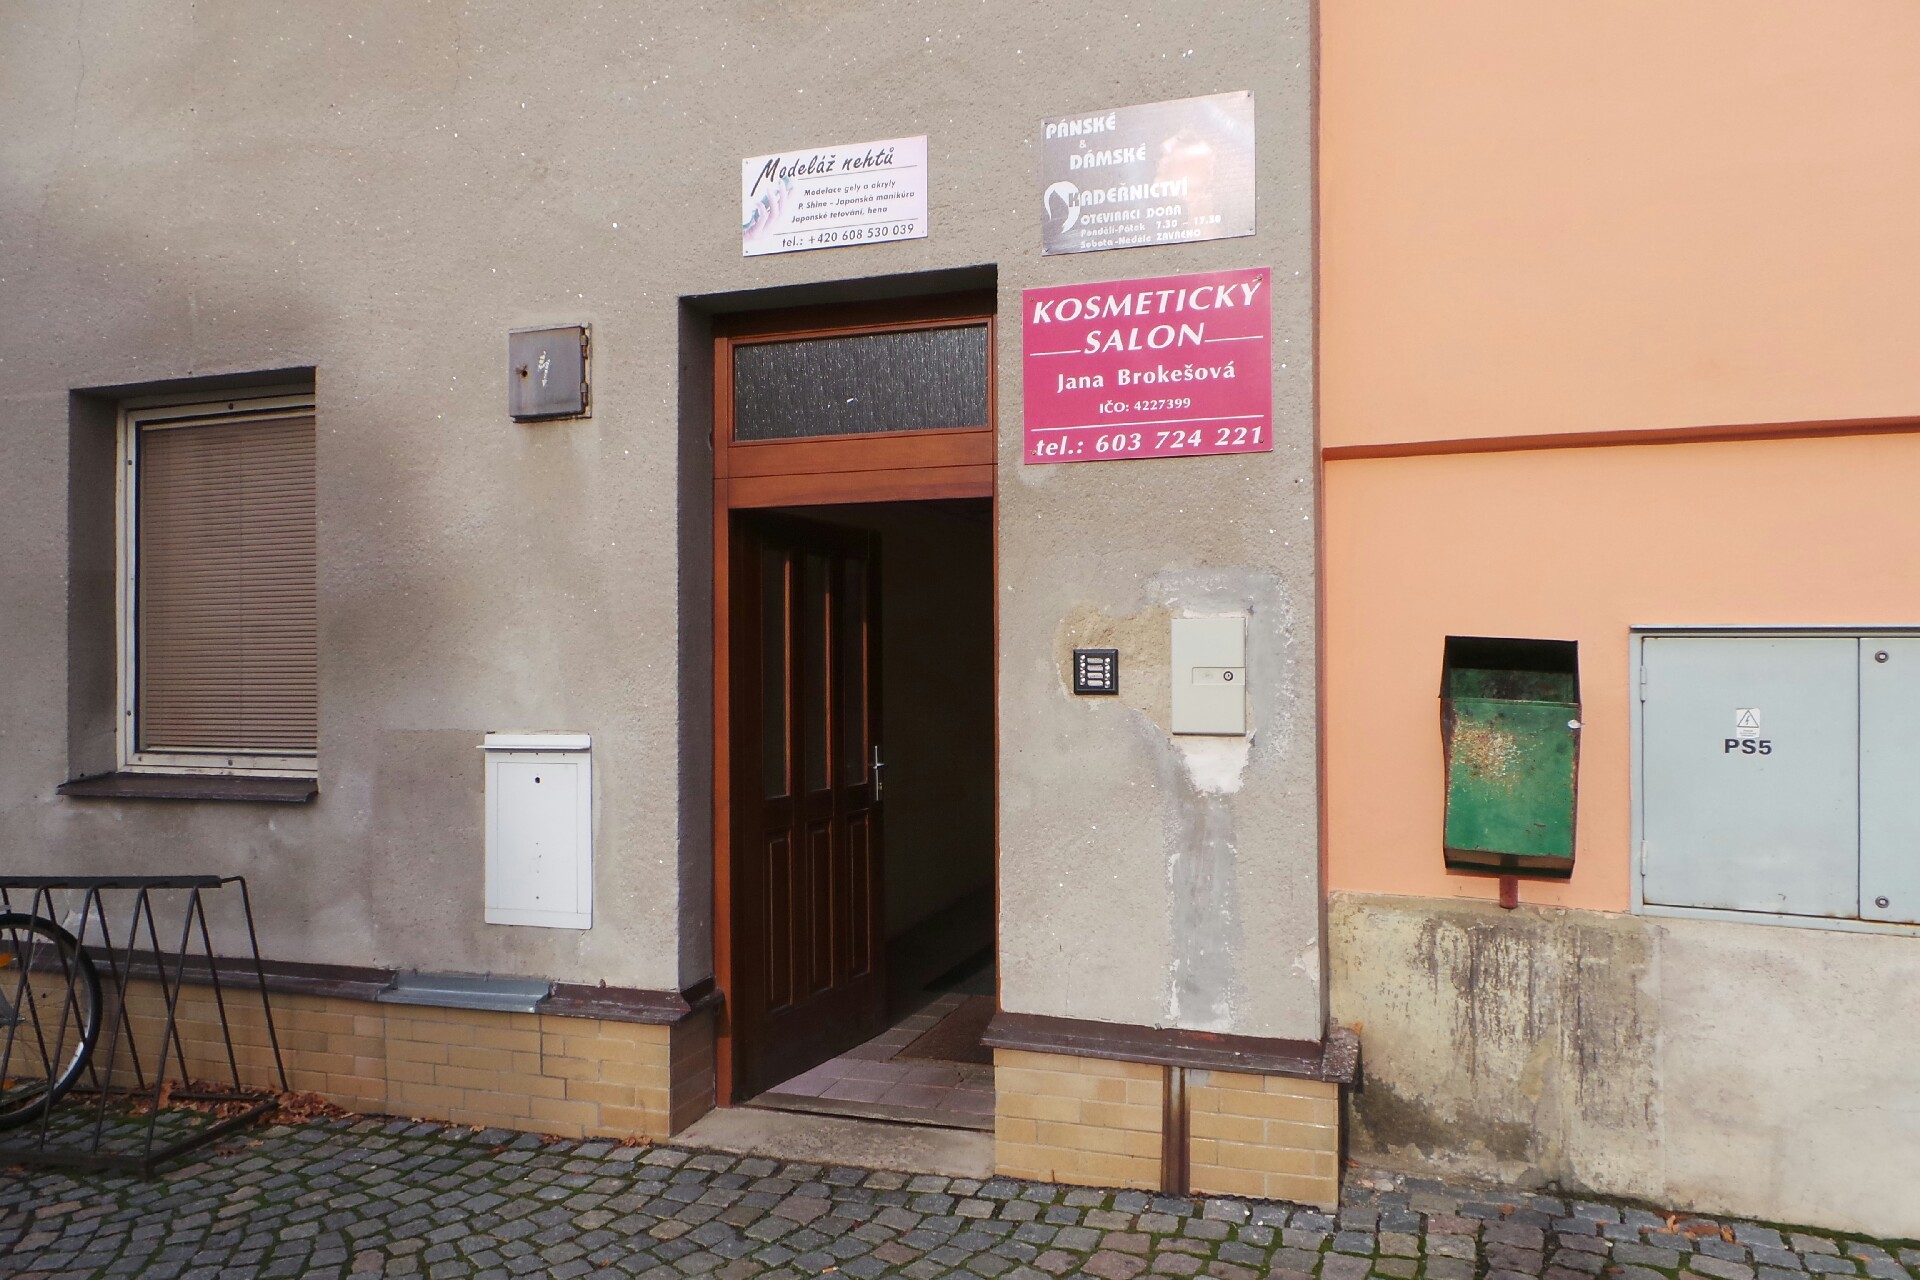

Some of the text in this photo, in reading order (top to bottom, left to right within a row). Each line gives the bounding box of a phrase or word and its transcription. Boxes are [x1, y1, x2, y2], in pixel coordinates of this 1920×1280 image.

[1046, 112, 1116, 139] PÁNSKÉ
[1079, 140, 1087, 149] &
[1070, 142, 1146, 170] DÁMSKÉ
[750, 147, 895, 197] Modeláž nehtů
[803, 186, 842, 196] Modelace
[844, 182, 861, 194] gely
[871, 179, 896, 190] akryly
[798, 202, 804, 210] P.
[806, 200, 827, 209] Shine
[835, 195, 874, 206] Japonská
[1146, 205, 1182, 219] DOBA
[791, 205, 888, 224] Japonské tetování, hena
[1156, 219, 1178, 230] 7.30
[782, 223, 914, 248] tel.: +420 608 530 039
[1032, 279, 1262, 324] KOSMETICKÝ
[1084, 322, 1205, 355] SALON
[1057, 361, 1235, 393] Jana Brokešová
[1099, 397, 1191, 414] IČO: 4227399
[1036, 426, 1262, 456] tel.: 603 724 221
[1724, 738, 1772, 755] PS5
